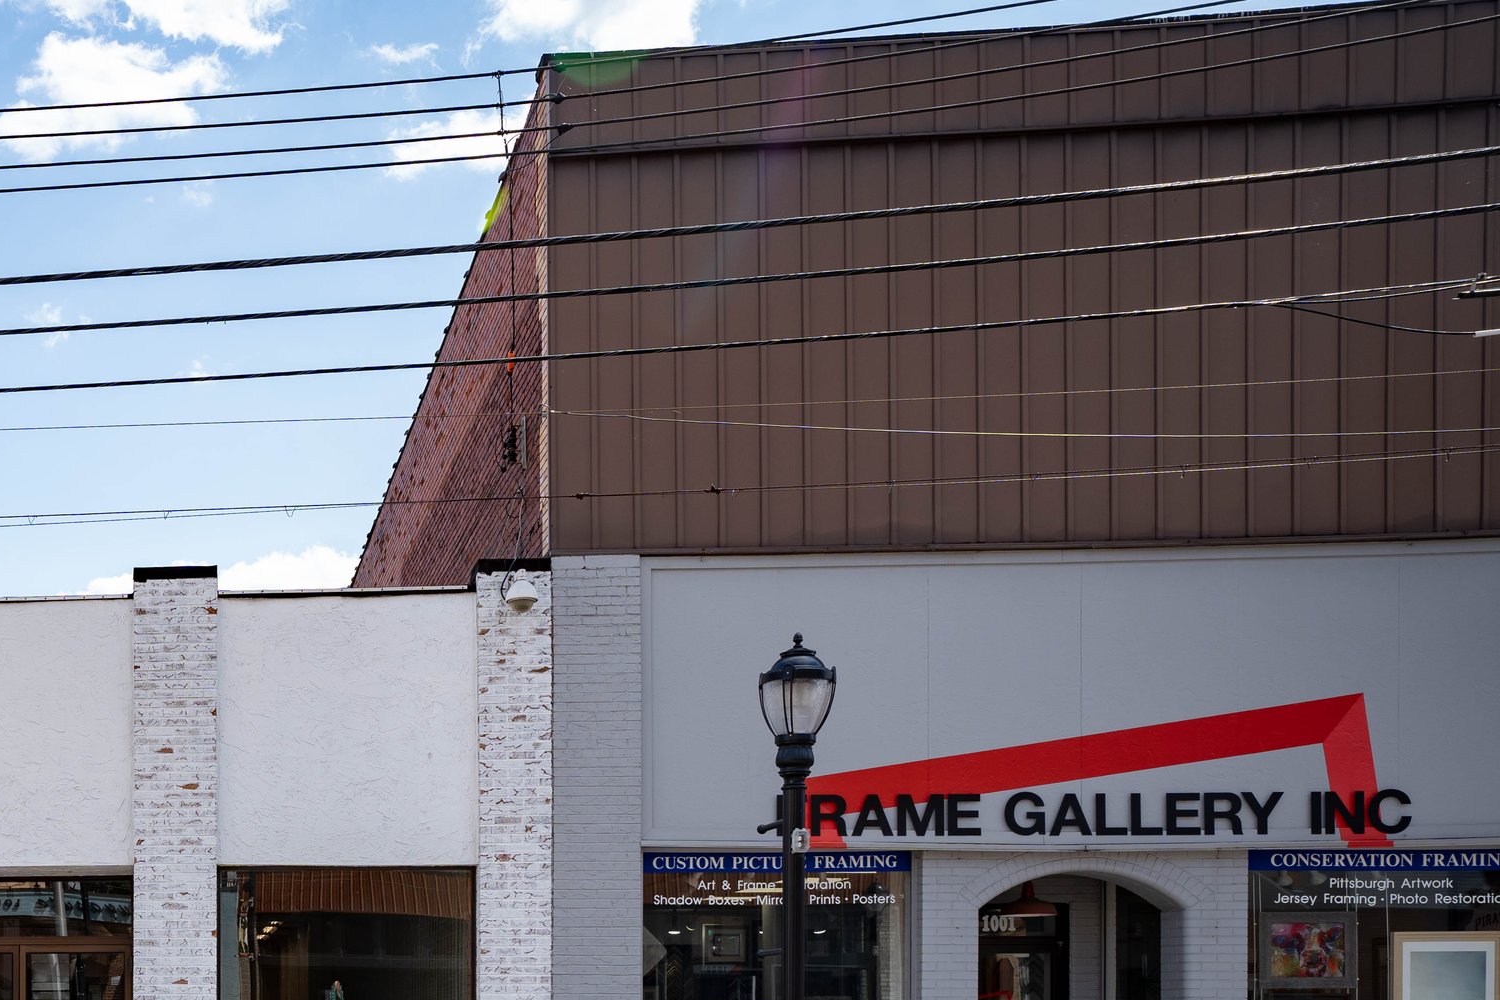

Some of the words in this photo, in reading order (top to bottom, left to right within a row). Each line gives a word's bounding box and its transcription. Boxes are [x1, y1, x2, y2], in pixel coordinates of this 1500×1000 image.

[1004, 791, 1283, 836] GALLERY
[1311, 788, 1412, 835] INC
[652, 856, 725, 870] CUSTOM
[732, 855, 807, 869] PICTU
[814, 854, 898, 868] FRAMING
[1270, 853, 1413, 867] CONSERVATION
[698, 880, 716, 890] Art
[722, 880, 731, 890] &
[737, 880, 776, 890] Frame
[804, 878, 851, 889] toration
[1329, 878, 1395, 891] Pittsburgh
[1401, 878, 1454, 889] Artwork
[653, 894, 702, 906] Shadow
[708, 894, 745, 906] Boxes
[809, 894, 841, 905] Prints
[853, 894, 896, 905] Posters
[1274, 893, 1317, 907] Jersey
[1323, 893, 1377, 907] Framing
[1389, 892, 1429, 905] Photo
[981, 915, 1016, 932] 1001
